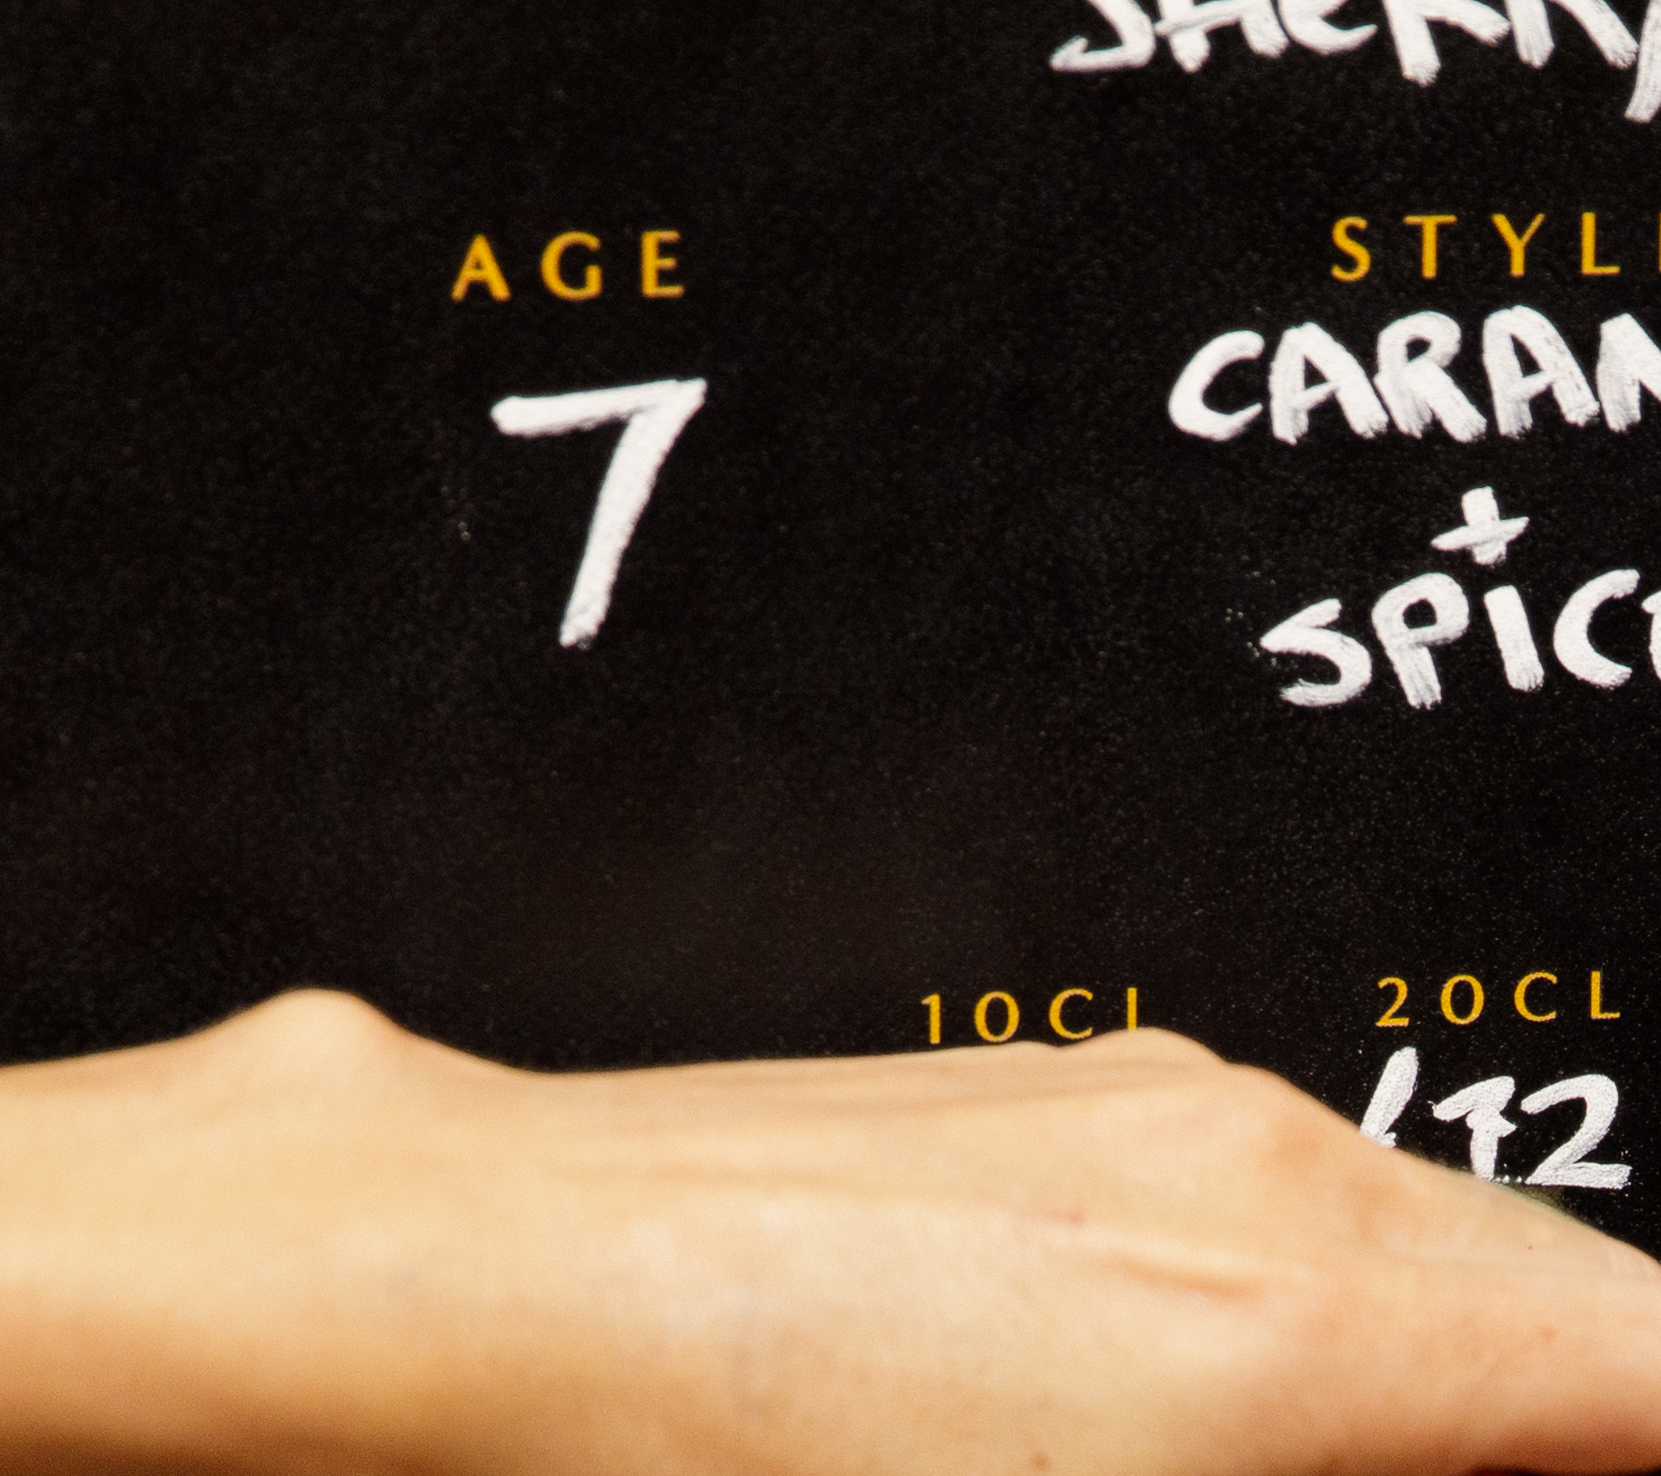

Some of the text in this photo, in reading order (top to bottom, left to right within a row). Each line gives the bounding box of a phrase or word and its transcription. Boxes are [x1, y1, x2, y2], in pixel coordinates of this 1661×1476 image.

[452, 231, 684, 300] AGE
[490, 377, 708, 648] 7
[1431, 486, 1529, 565] +
[1375, 970, 1621, 1028] 20CL
